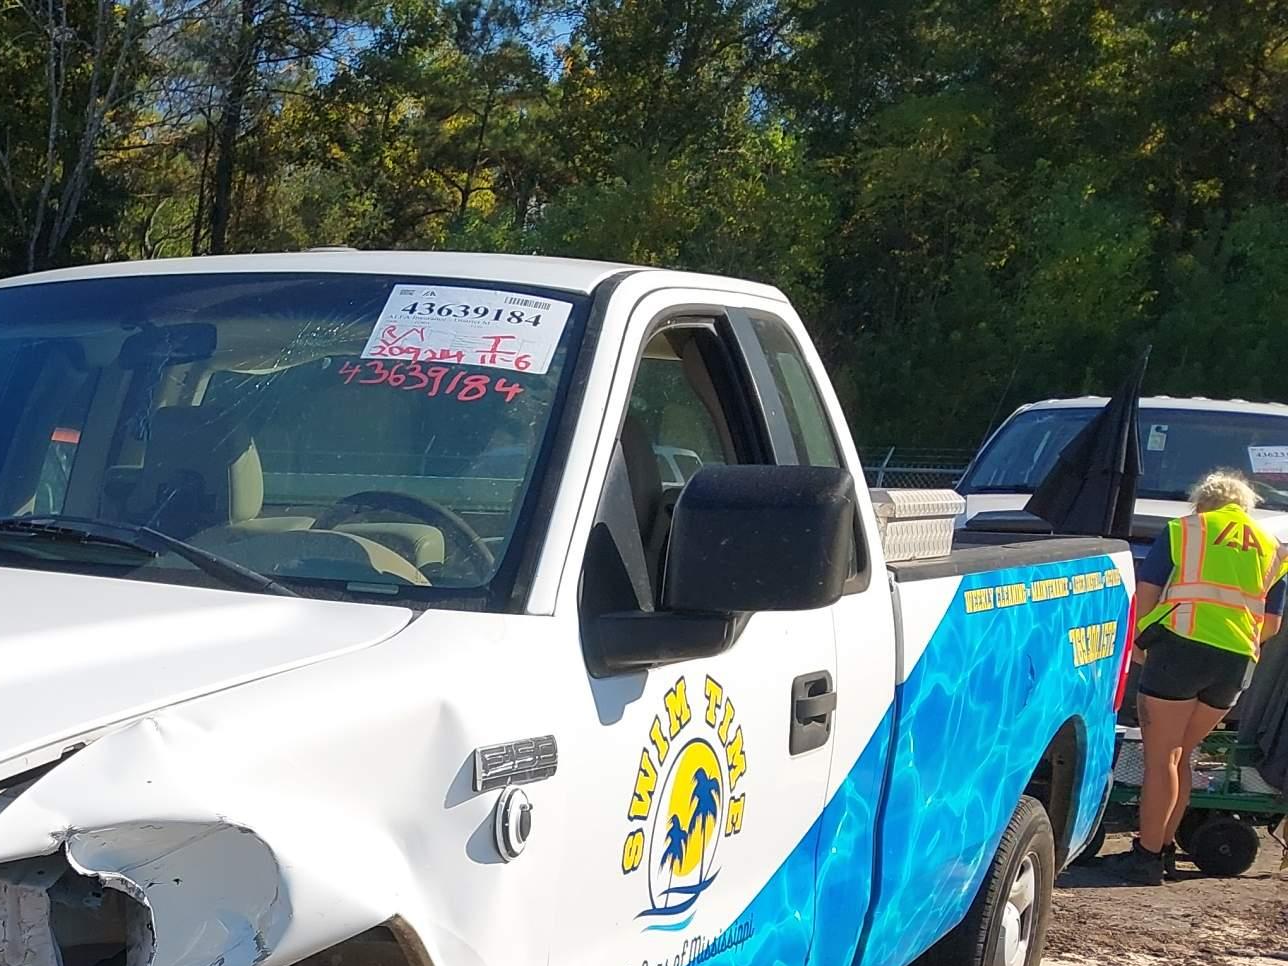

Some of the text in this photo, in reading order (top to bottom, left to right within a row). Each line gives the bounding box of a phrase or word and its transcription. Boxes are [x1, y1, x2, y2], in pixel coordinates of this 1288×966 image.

[401, 301, 542, 327] 43639184
[338, 358, 524, 402] 43639184
[622, 673, 748, 875] SWIM TIME
